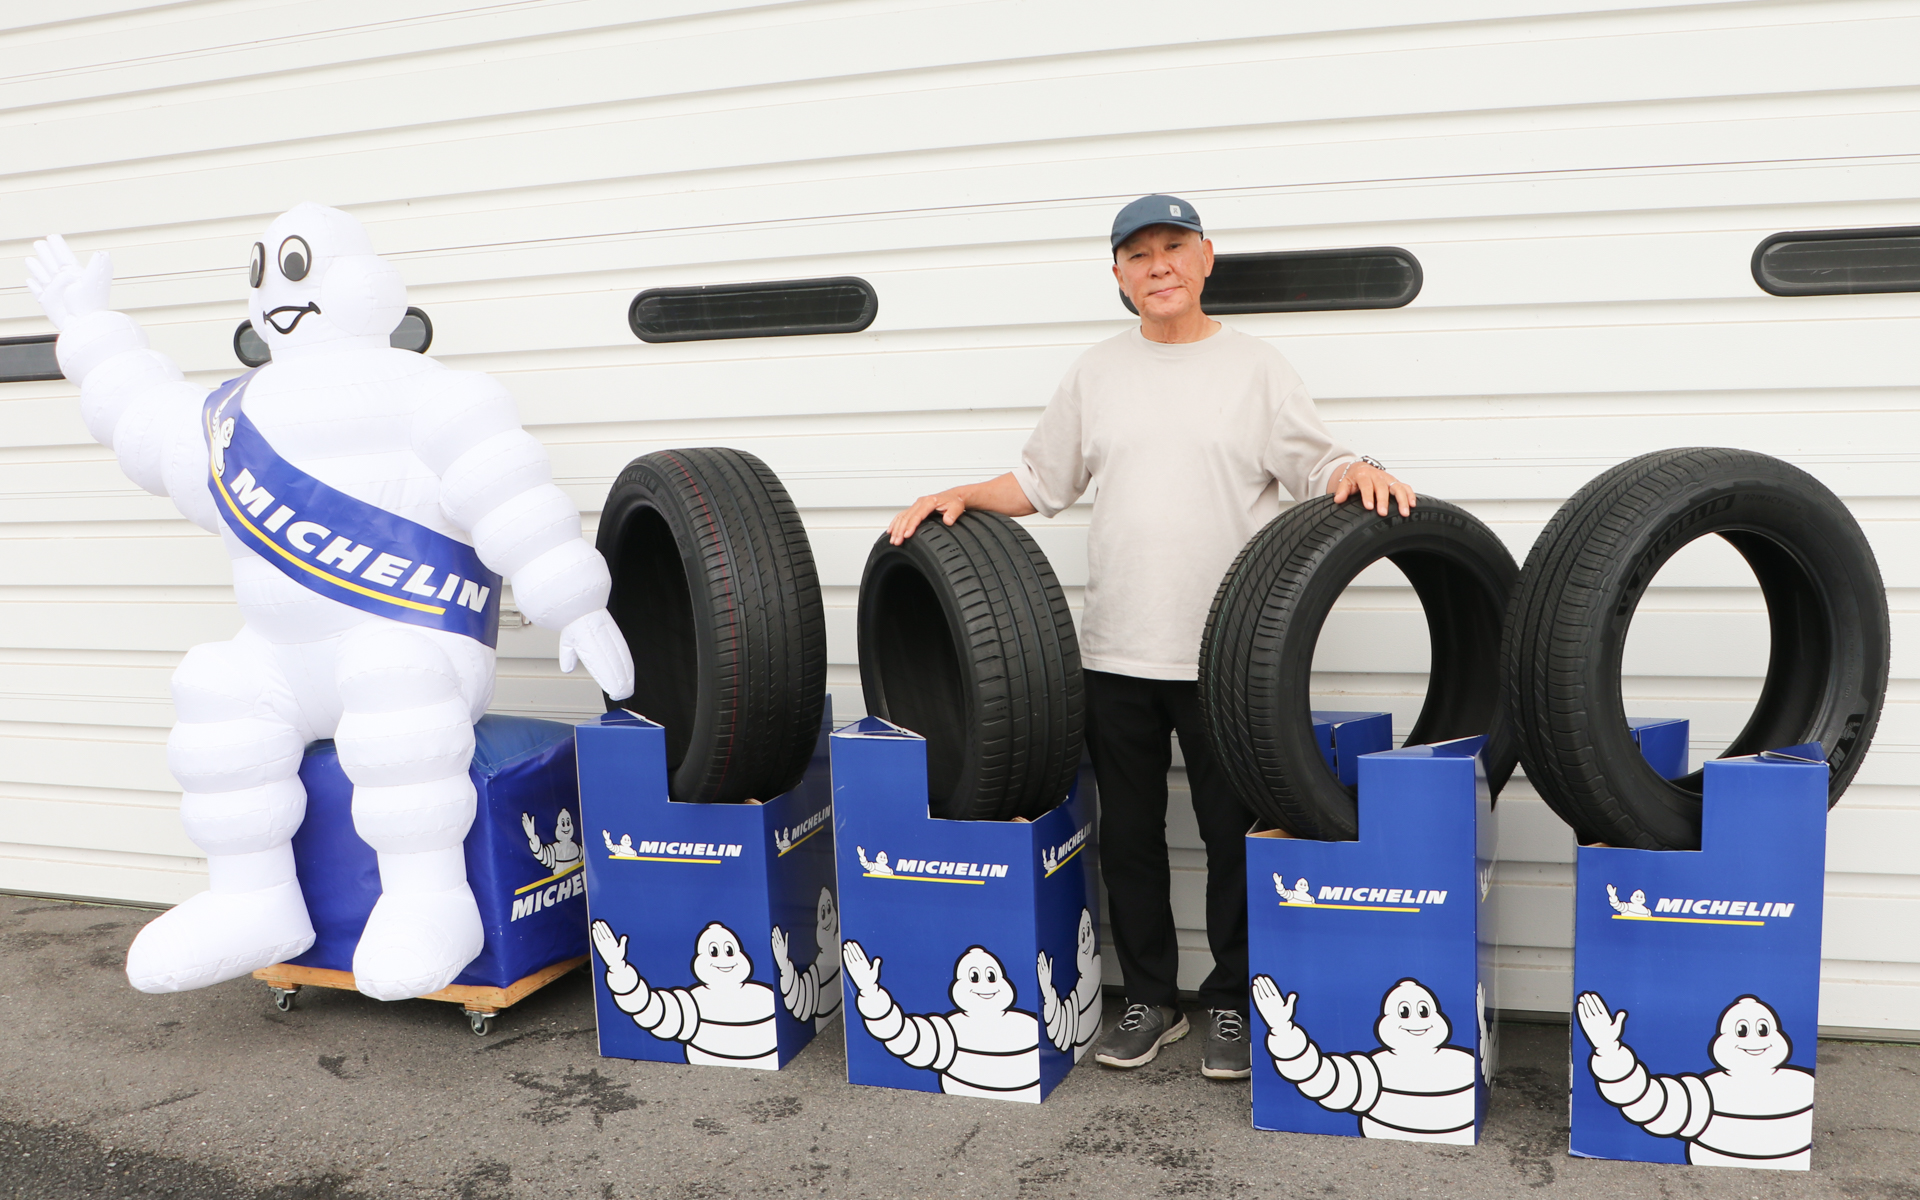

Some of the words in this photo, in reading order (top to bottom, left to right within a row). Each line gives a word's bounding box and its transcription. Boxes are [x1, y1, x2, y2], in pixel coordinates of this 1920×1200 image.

[617, 469, 659, 492] MICHELIN
[230, 467, 490, 612] MICHELIN
[1637, 496, 1730, 580] MICHELIN
[791, 804, 832, 841] MICHELIN
[639, 841, 742, 857] MICHELIN
[1057, 821, 1092, 860] MICHELIN
[896, 859, 1009, 878] MICHELIN
[1318, 886, 1448, 905] MICHELIN
[1655, 898, 1796, 917] MICHELIN
